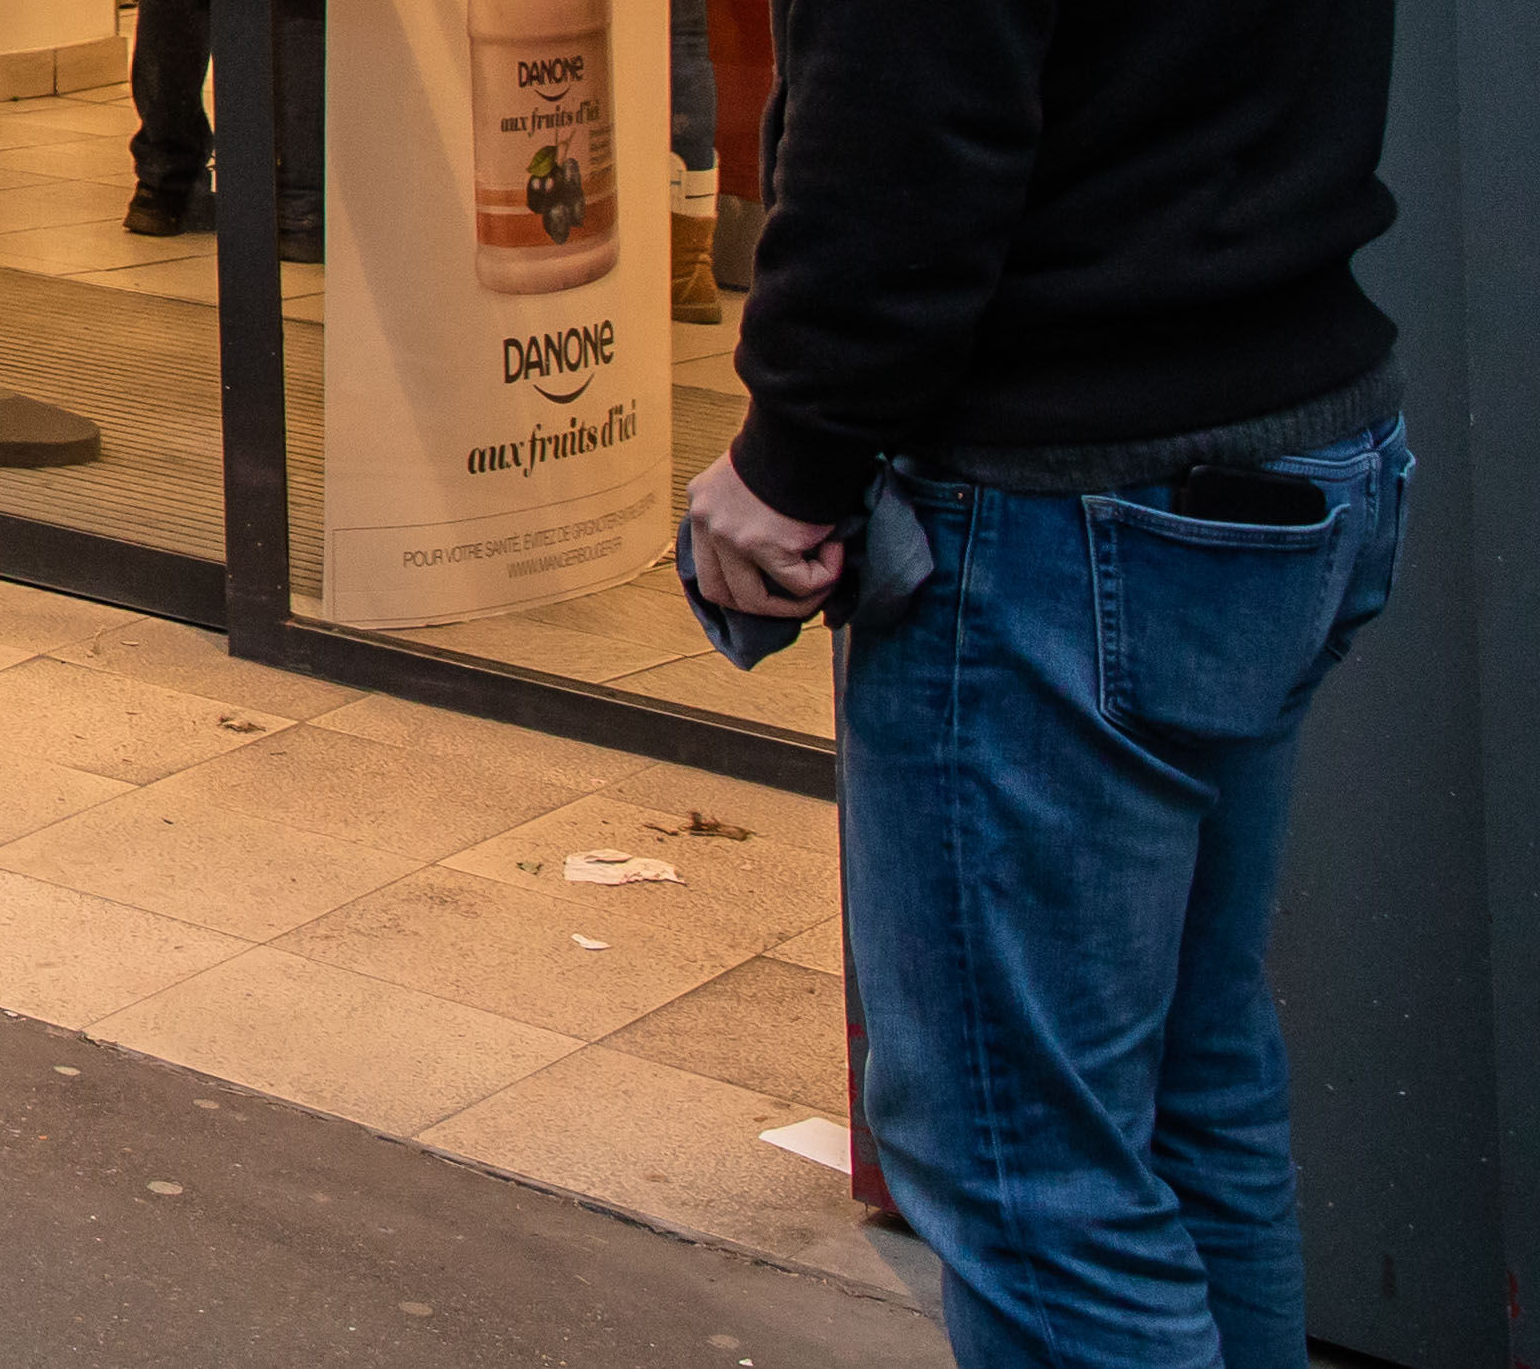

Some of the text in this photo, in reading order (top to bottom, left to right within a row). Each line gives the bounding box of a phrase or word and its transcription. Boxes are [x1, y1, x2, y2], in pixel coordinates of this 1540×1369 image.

[467, 399, 636, 478] aux fruits d'ici
[404, 548, 443, 568] POUR
[445, 542, 483, 562] VOTRE
